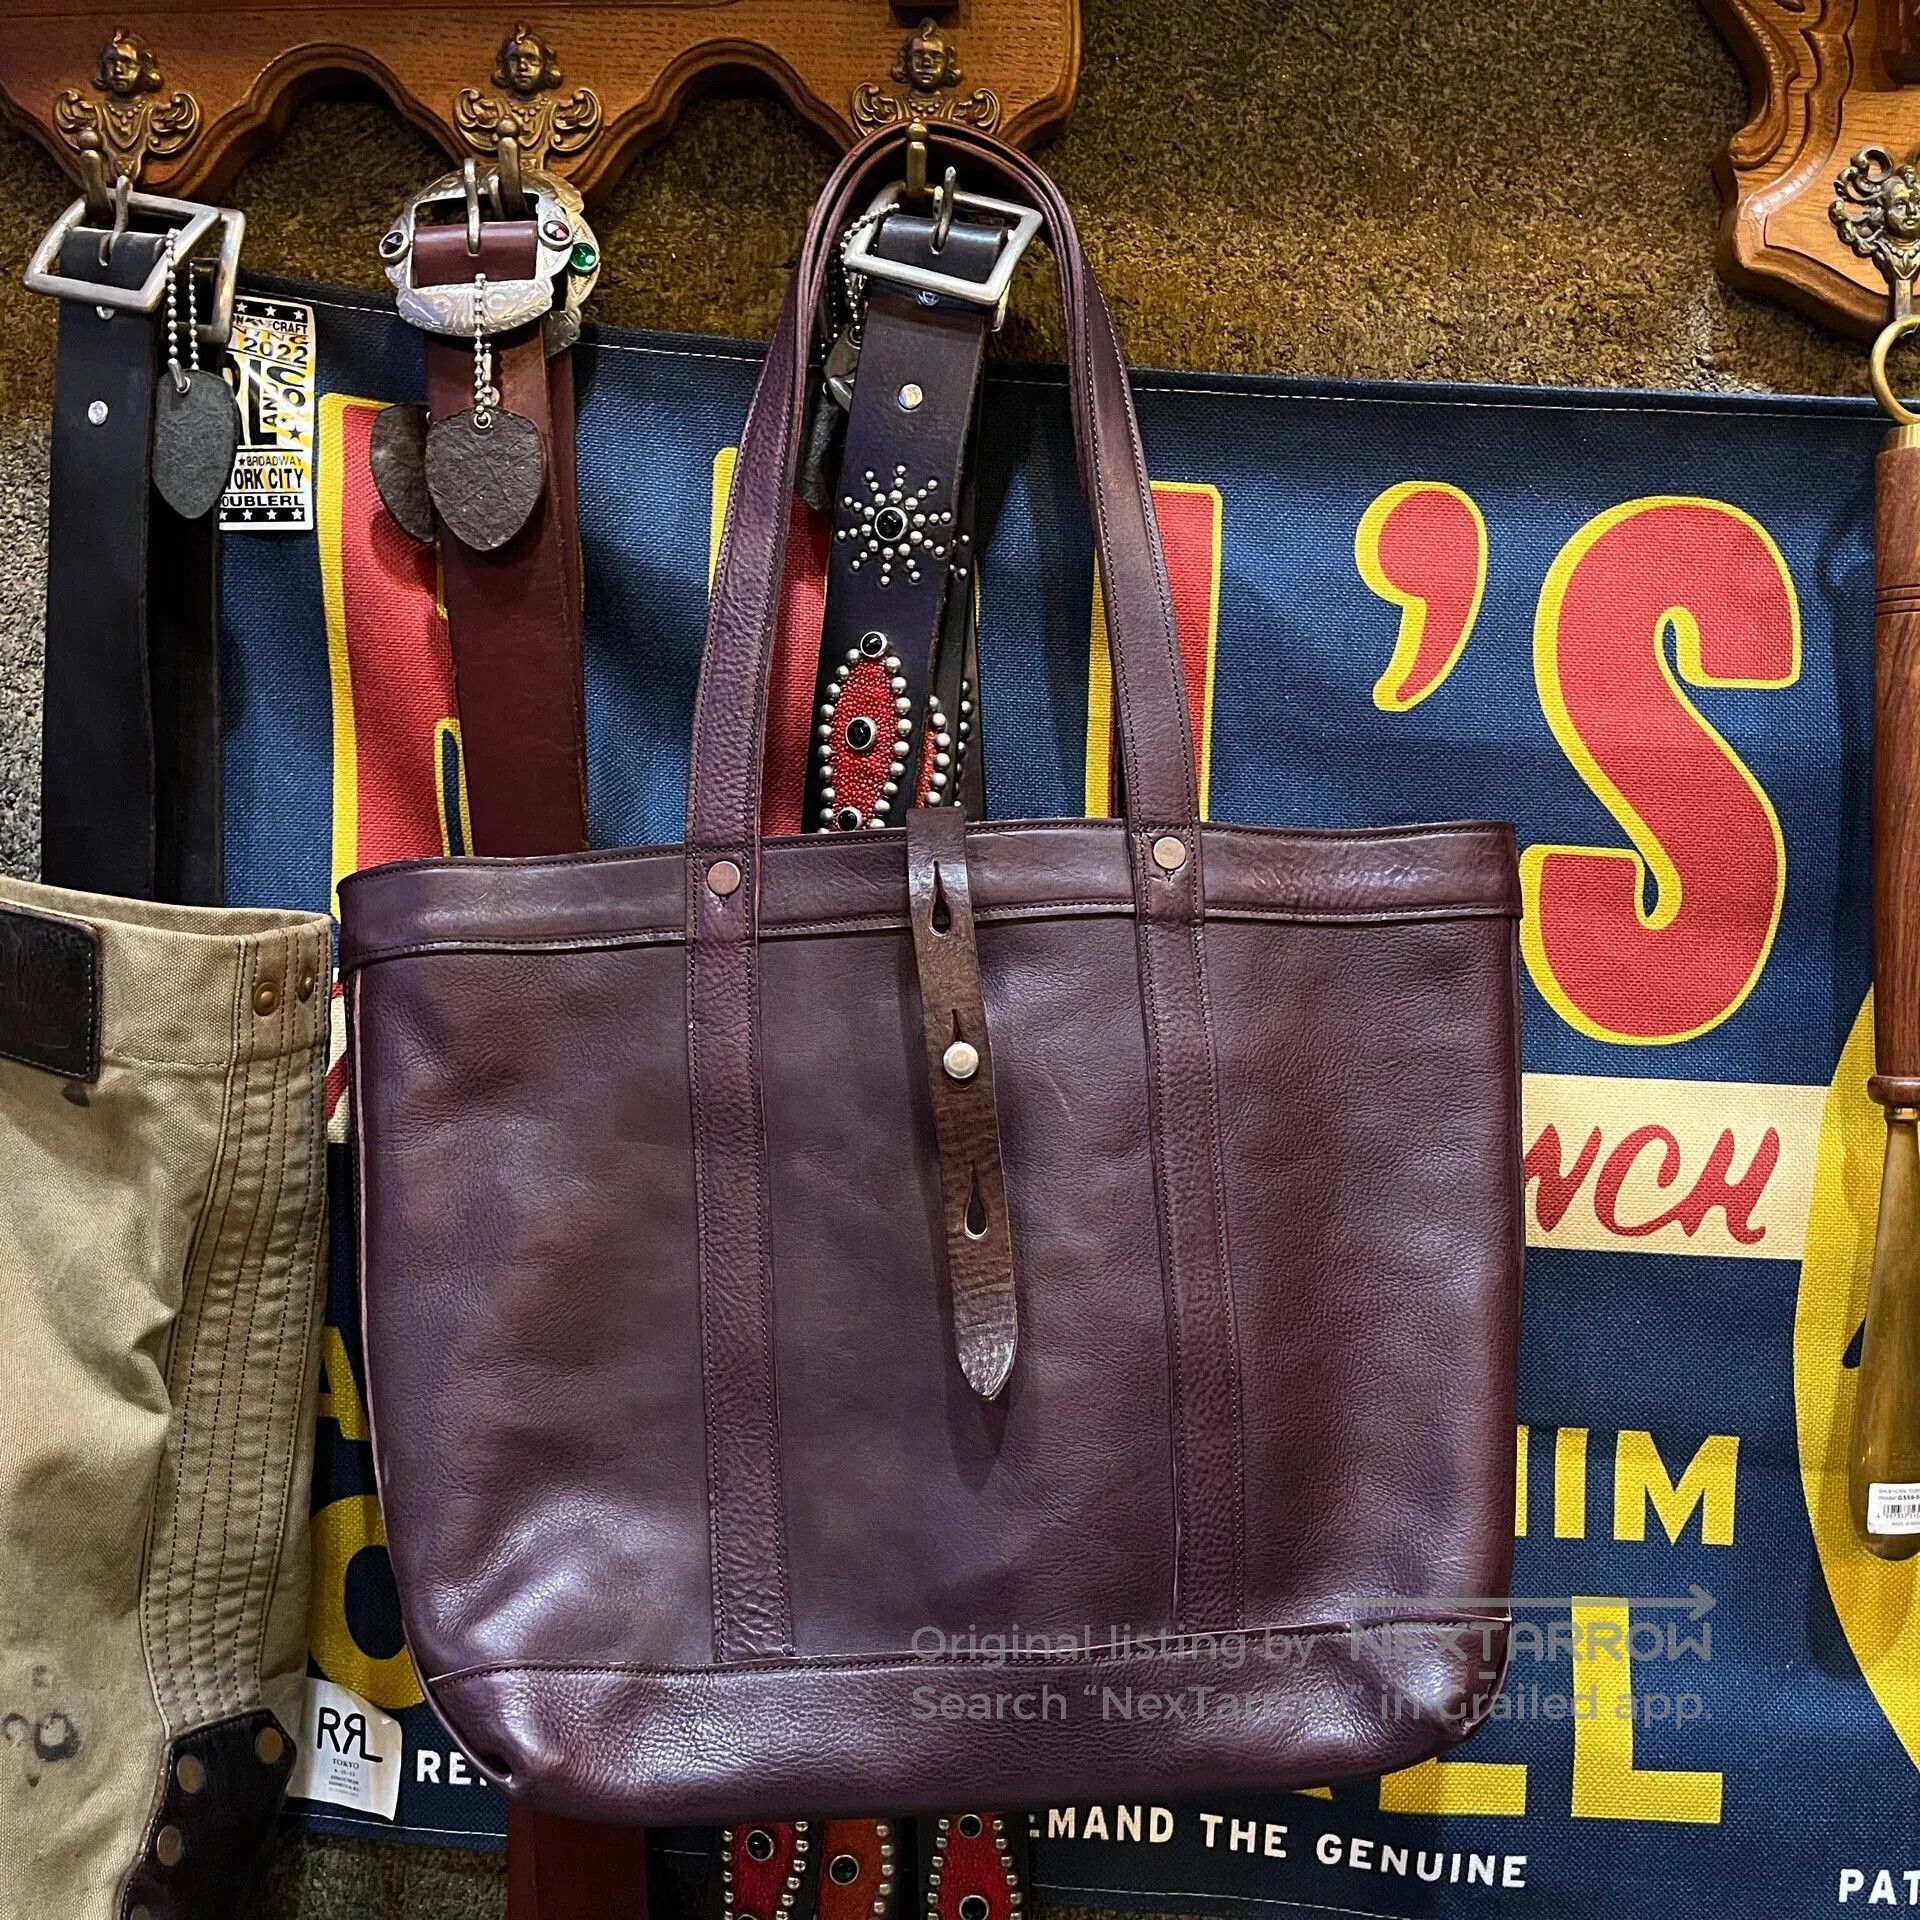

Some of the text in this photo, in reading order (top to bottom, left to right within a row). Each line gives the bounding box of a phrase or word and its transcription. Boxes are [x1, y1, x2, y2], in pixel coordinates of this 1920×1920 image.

[272, 320, 308, 335] CRAFT
[243, 336, 308, 366] 2022
[246, 456, 302, 467] BROADWAY
[225, 468, 304, 490] ORK CITY
[222, 495, 304, 508] OUBLERL
[332, 1758, 360, 1770] TOKYO
[416, 1749, 487, 1787] RE
[1200, 1813, 1288, 1858] THE
[1316, 1833, 1527, 1888] GENUINE
